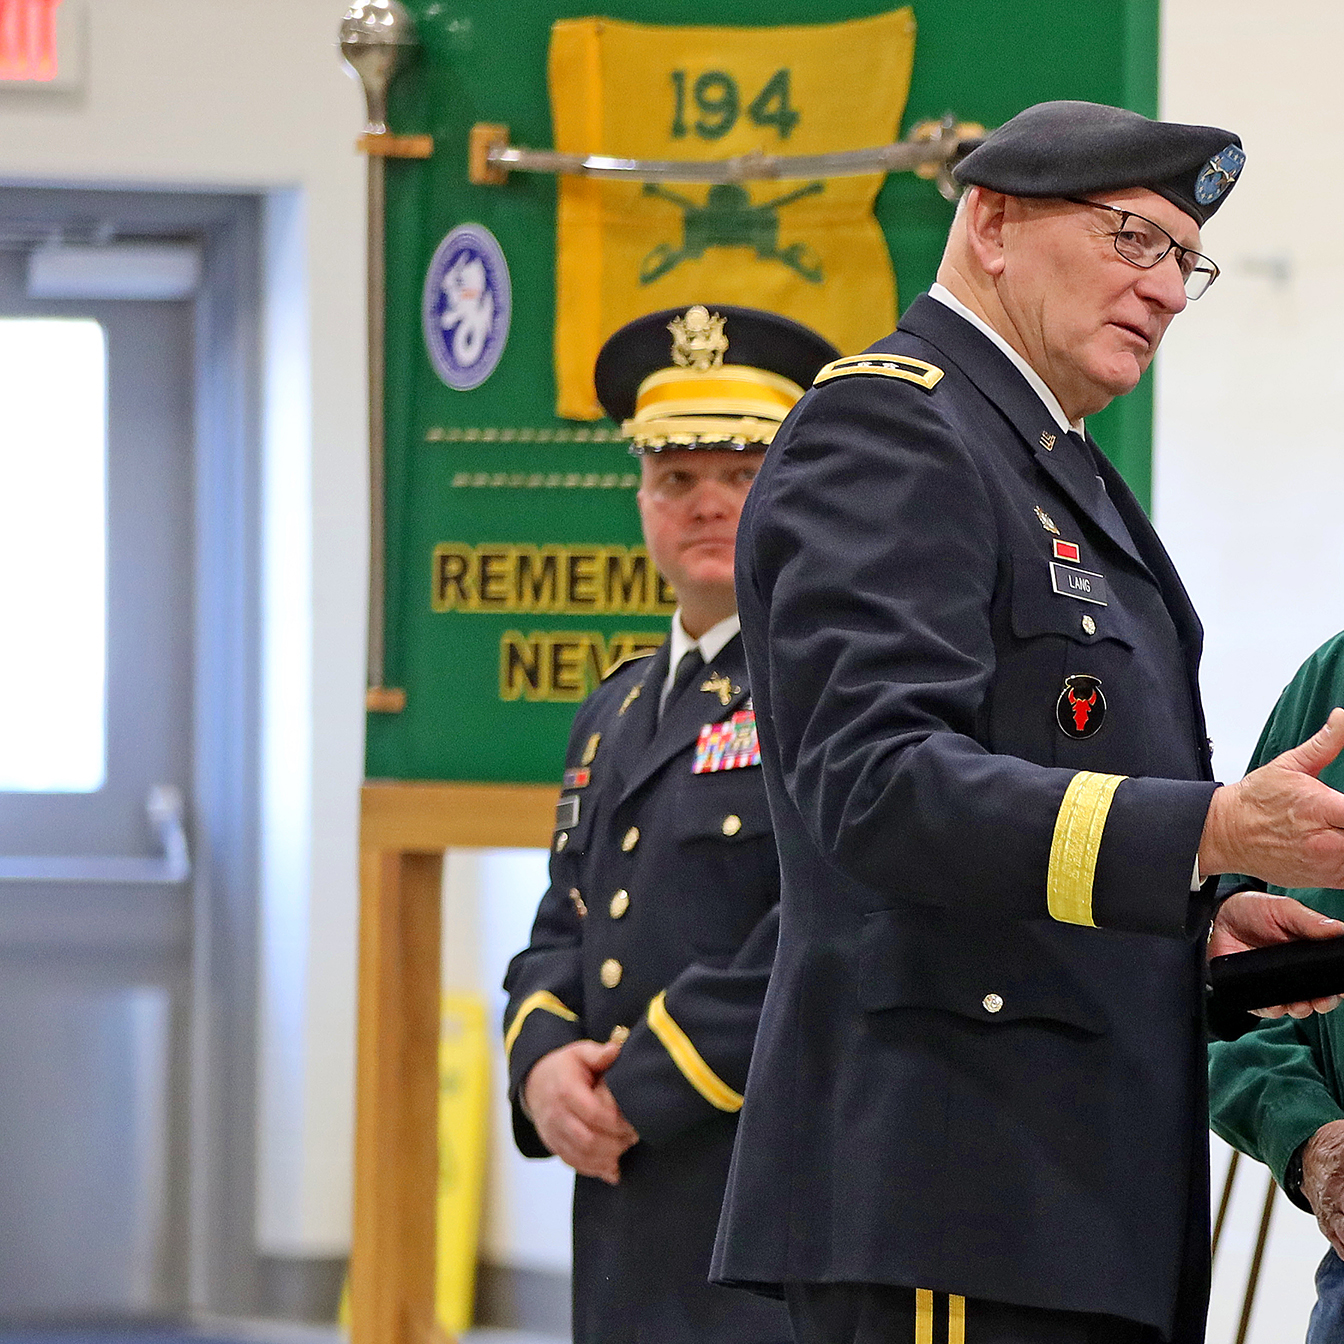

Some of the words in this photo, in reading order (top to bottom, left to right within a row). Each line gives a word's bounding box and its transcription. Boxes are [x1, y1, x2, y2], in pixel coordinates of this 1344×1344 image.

[670, 67, 800, 140] 194
[1068, 574, 1091, 592] LANG
[503, 639, 658, 693] NEV
